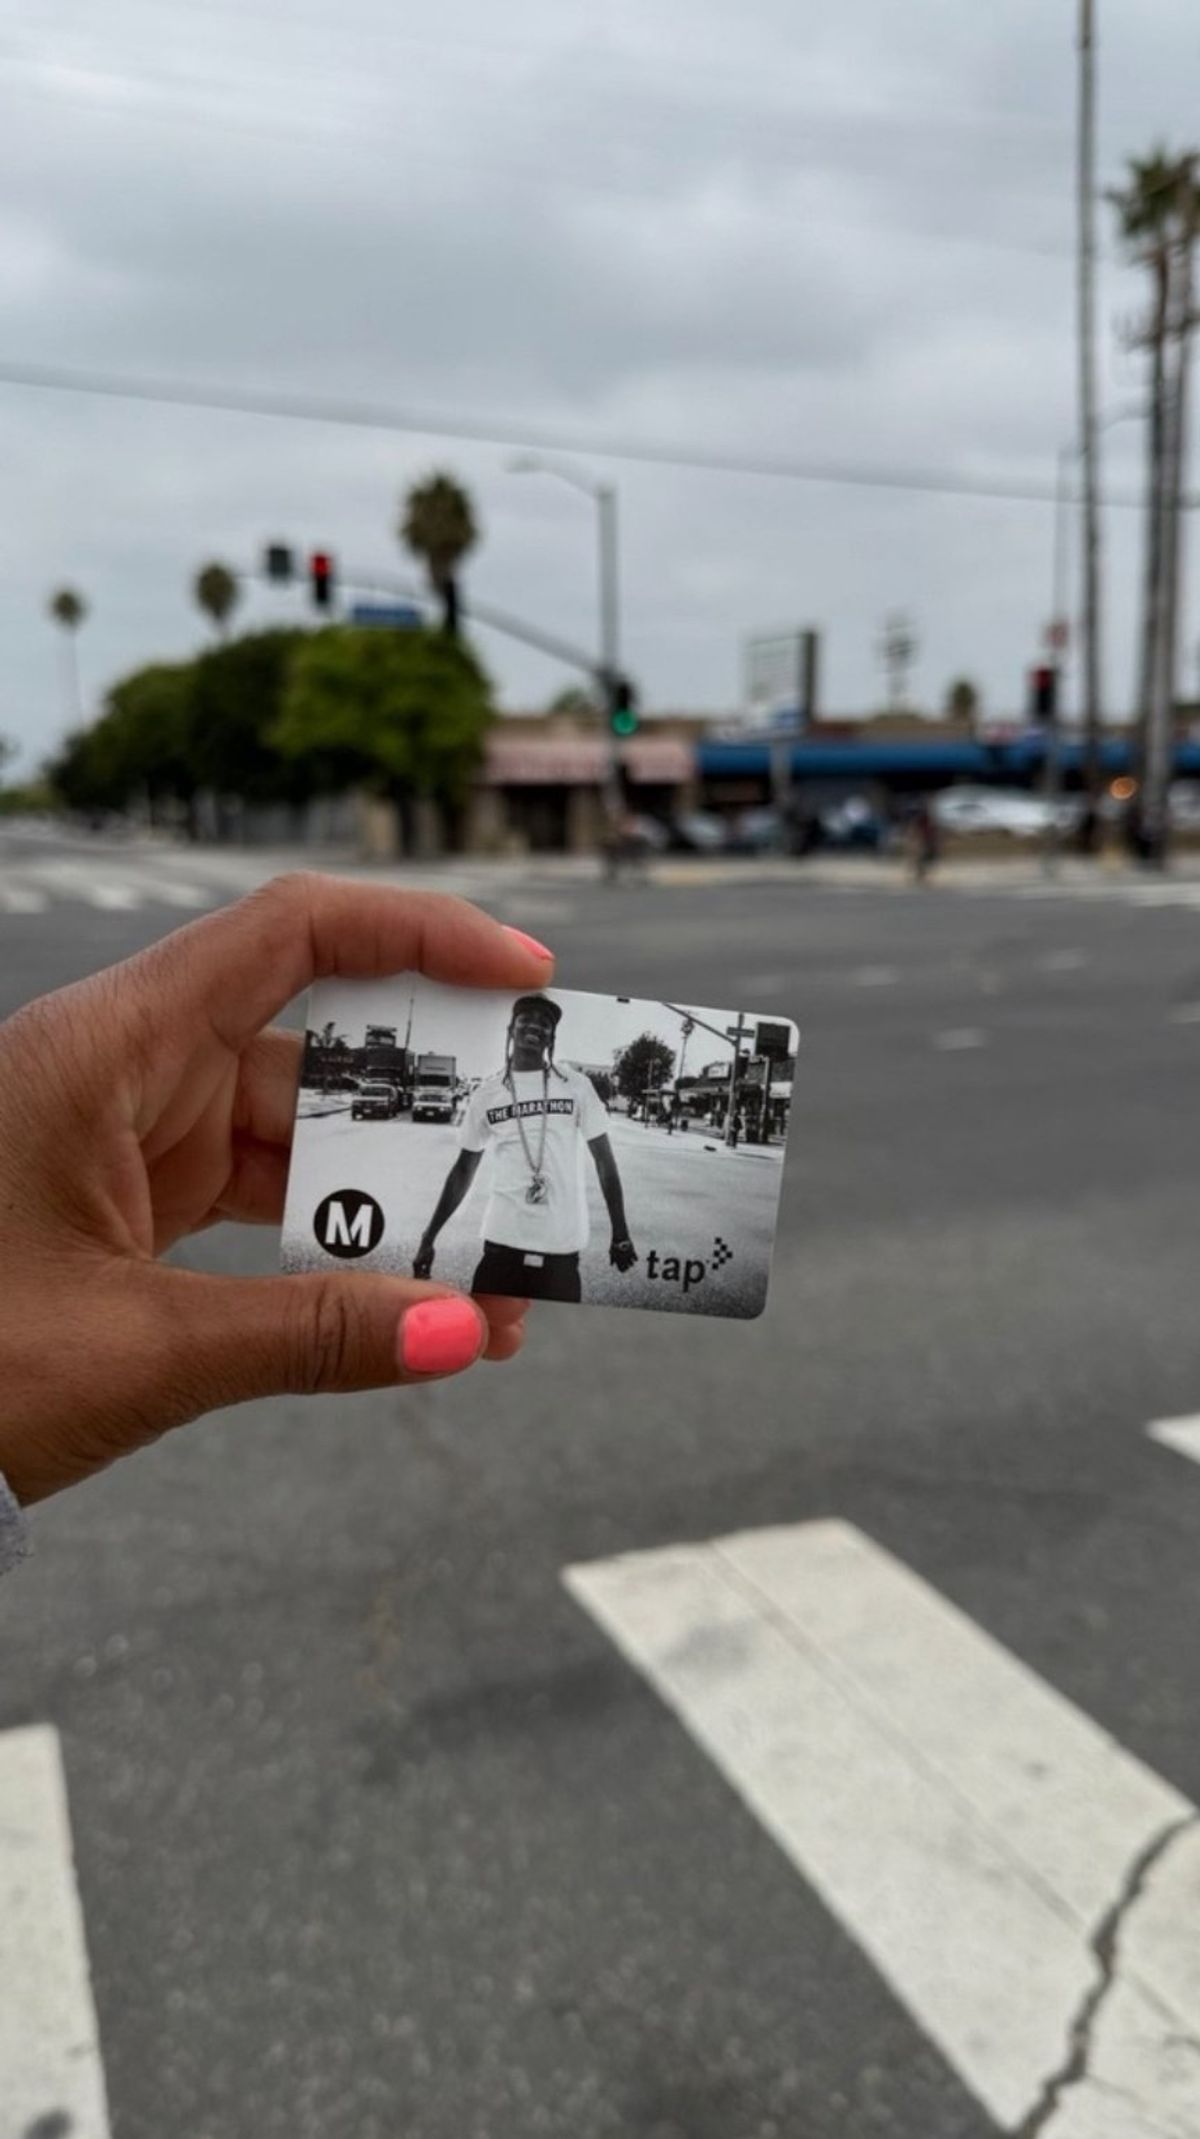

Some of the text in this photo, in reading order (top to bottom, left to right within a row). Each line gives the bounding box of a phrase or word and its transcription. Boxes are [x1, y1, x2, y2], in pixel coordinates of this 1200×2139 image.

[489, 1100, 572, 1122] THE MARATHON
[325, 1201, 373, 1247] M
[647, 1250, 705, 1293] tap
